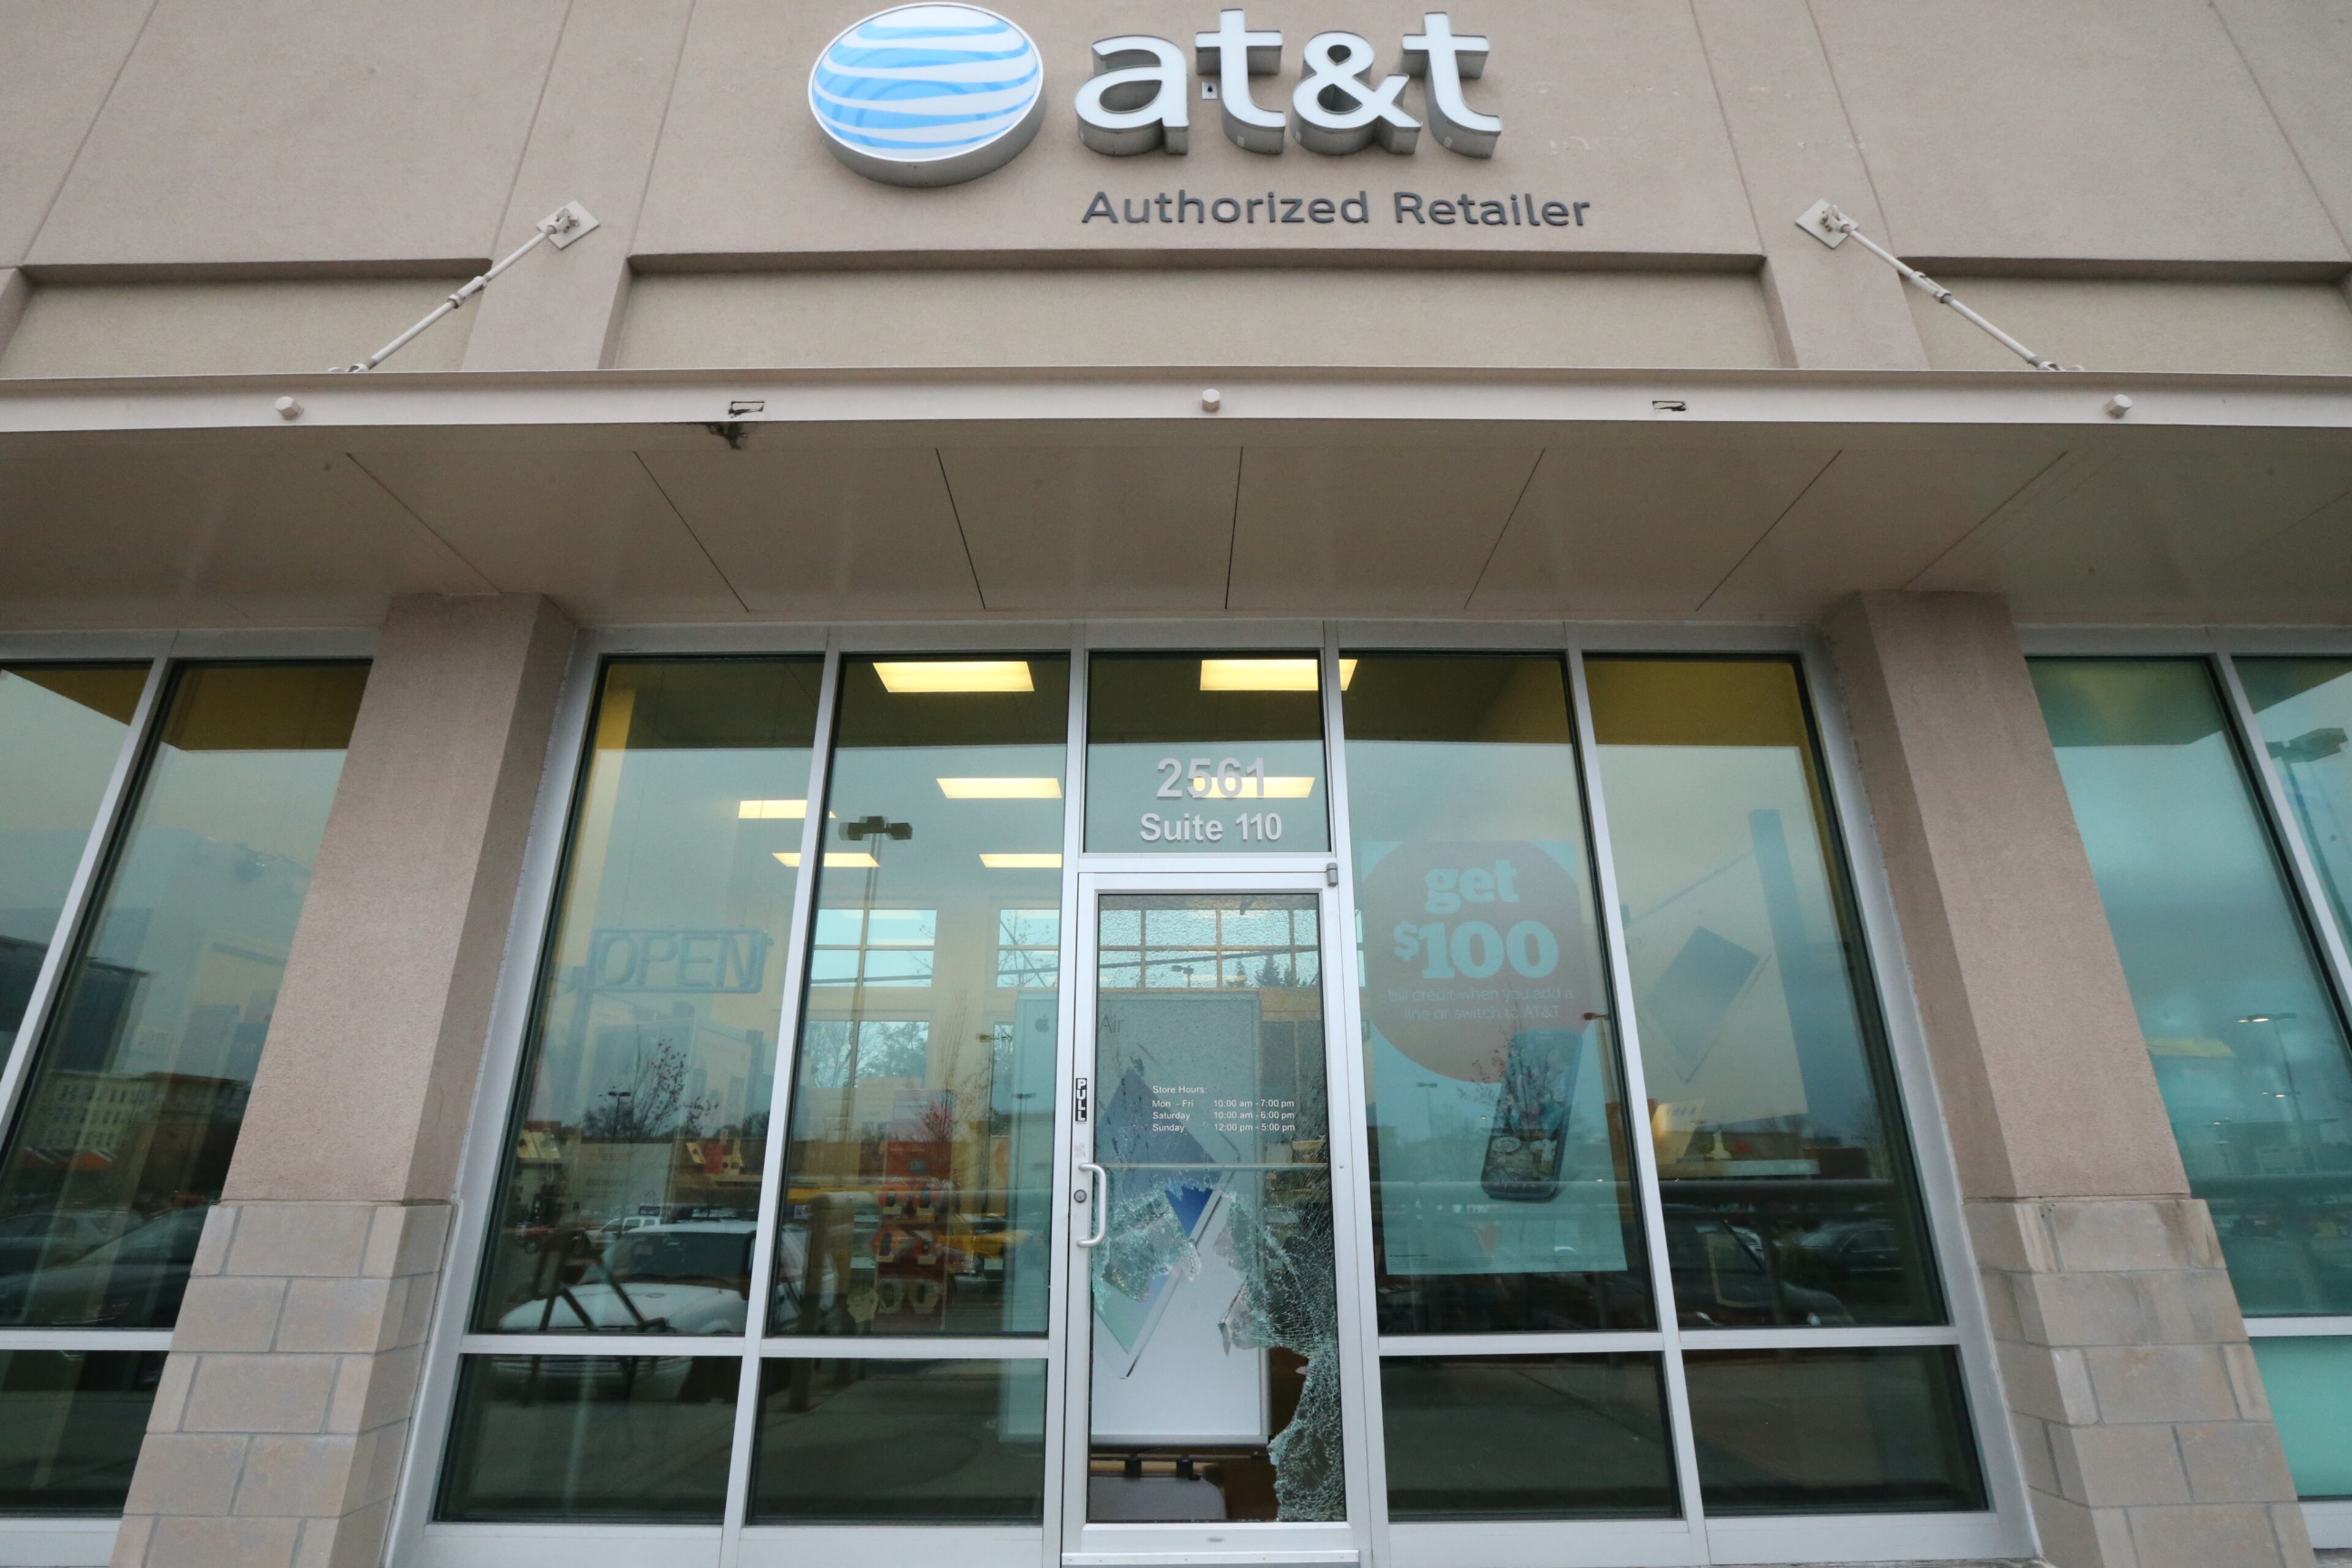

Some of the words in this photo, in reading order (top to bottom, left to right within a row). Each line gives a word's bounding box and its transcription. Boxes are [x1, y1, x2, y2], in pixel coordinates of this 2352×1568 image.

[1074, 8, 1502, 157] at&t
[1082, 189, 1369, 225] Authorized
[1393, 190, 1590, 227] Retailer
[1156, 757, 1265, 799] 2561
[1140, 812, 1223, 841] Suite
[1235, 812, 1283, 841] 110
[1424, 859, 1520, 914] get
[599, 933, 761, 989] OPEN
[1393, 920, 1559, 979] $100
[1387, 989, 1408, 1001] bill
[1412, 988, 1454, 1001] credit
[1460, 987, 1499, 1000] when
[1502, 989, 1529, 1002] you
[1532, 987, 1560, 1000] add
[1564, 989, 1574, 999] a
[1404, 1008, 1431, 1020] line
[1434, 1009, 1449, 1020] or
[1453, 1006, 1501, 1019] switch
[1504, 1008, 1519, 1019] to
[1523, 1005, 1561, 1018] AT&T
[1076, 1079, 1087, 1121] PULL
[1152, 1112, 1190, 1121] Saturday
[1152, 1123, 1185, 1133] Sunday
